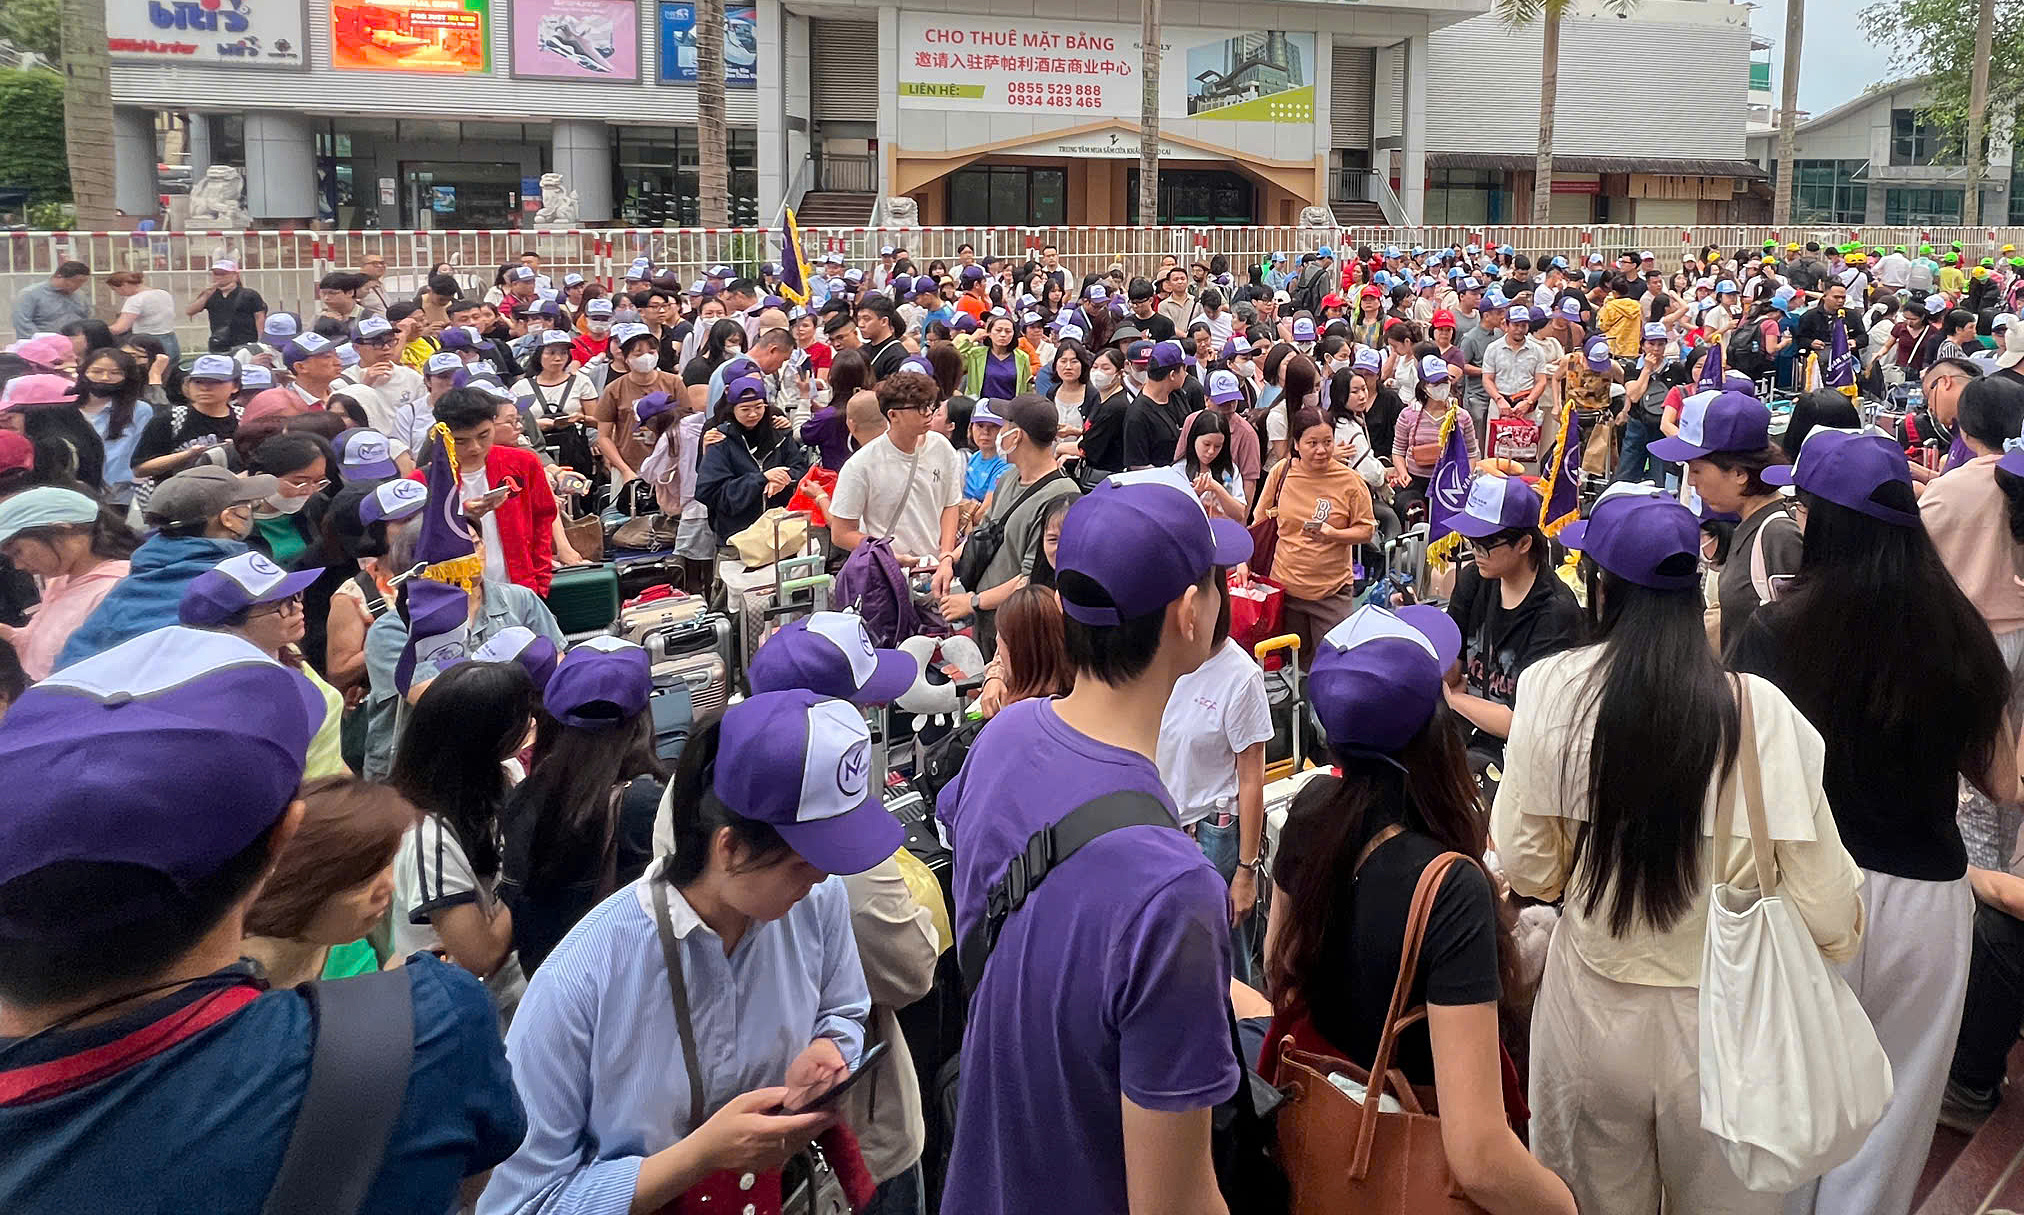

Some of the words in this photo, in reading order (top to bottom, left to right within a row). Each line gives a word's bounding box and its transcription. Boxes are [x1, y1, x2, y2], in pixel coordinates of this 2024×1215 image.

[925, 28, 964, 44] CHO
[969, 29, 1017, 46] THUÊ
[1023, 31, 1060, 51] MẶT
[915, 51, 1132, 76] 邀请入驻萨帕利酒店商业中心
[909, 82, 936, 95] LIÊN
[1008, 82, 1044, 93] 0855
[1048, 83, 1072, 94] 529
[1075, 85, 1101, 96] 888
[1008, 94, 1042, 106] 0934
[1047, 96, 1072, 107] 483
[1076, 97, 1102, 108] 465
[1312, 497, 1331, 523] B
